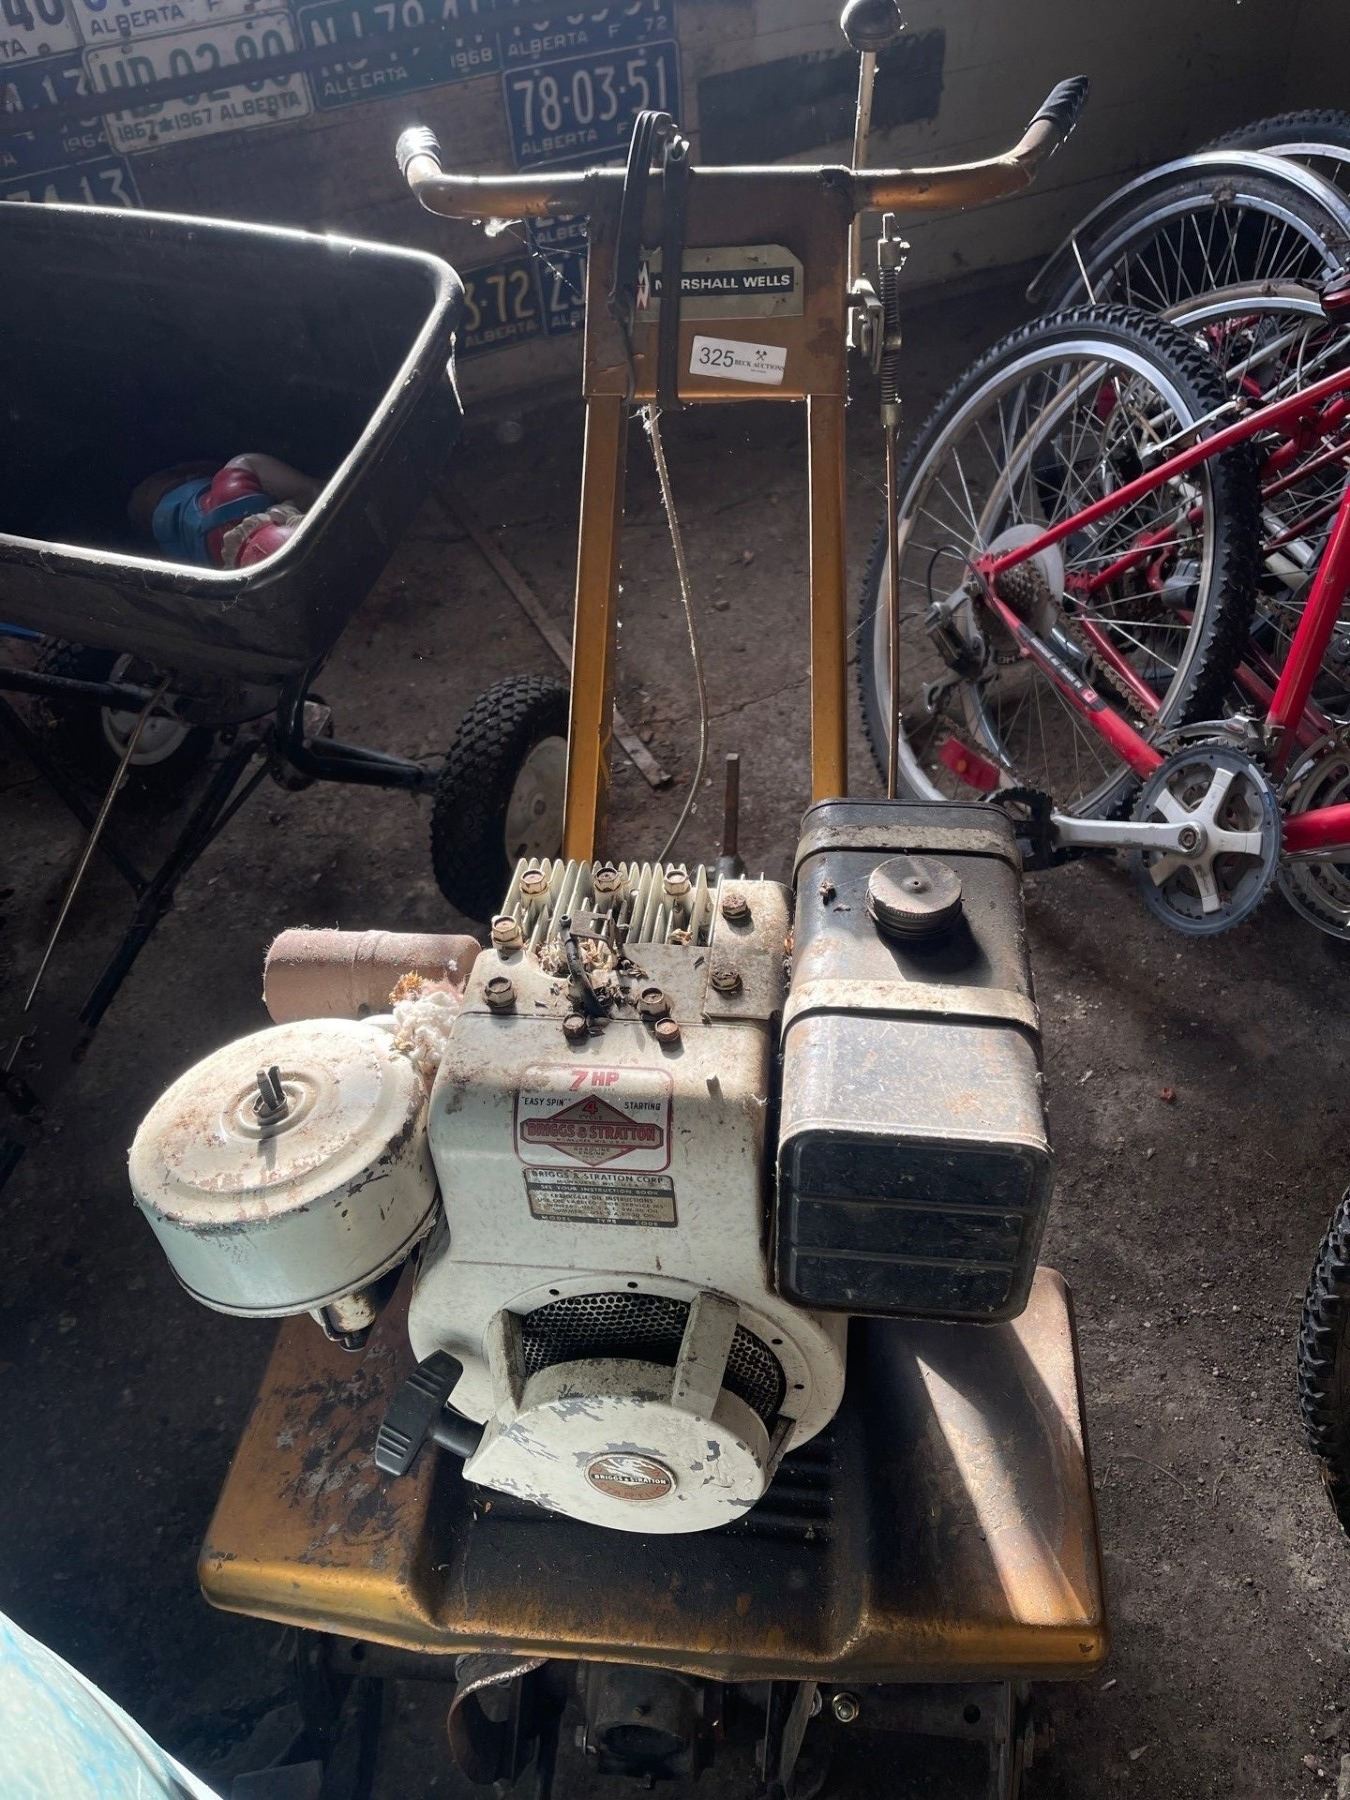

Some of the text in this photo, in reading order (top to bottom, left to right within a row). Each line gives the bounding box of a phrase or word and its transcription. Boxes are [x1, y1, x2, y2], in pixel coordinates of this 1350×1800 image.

[91, 5, 185, 37] ALBERTA
[508, 30, 590, 57] ALBERTA
[608, 23, 621, 38] F
[643, 16, 668, 32] 72
[449, 47, 493, 69] 1968
[220, 90, 302, 121] ALBERTA
[521, 127, 598, 156] ALBERTA
[655, 274, 791, 291] MRSHALL WELLS
[465, 319, 537, 348] ALBERTA
[699, 346, 735, 368] 325
[569, 1071, 620, 1090] 7 HP
[582, 1101, 599, 1115] 4
[624, 1102, 661, 1111] STARTING
[527, 1122, 576, 1138] BRIGGS
[589, 1126, 656, 1142] STRATTON
[531, 1170, 569, 1179] BRIGGS
[583, 1173, 633, 1183] STRATTON
